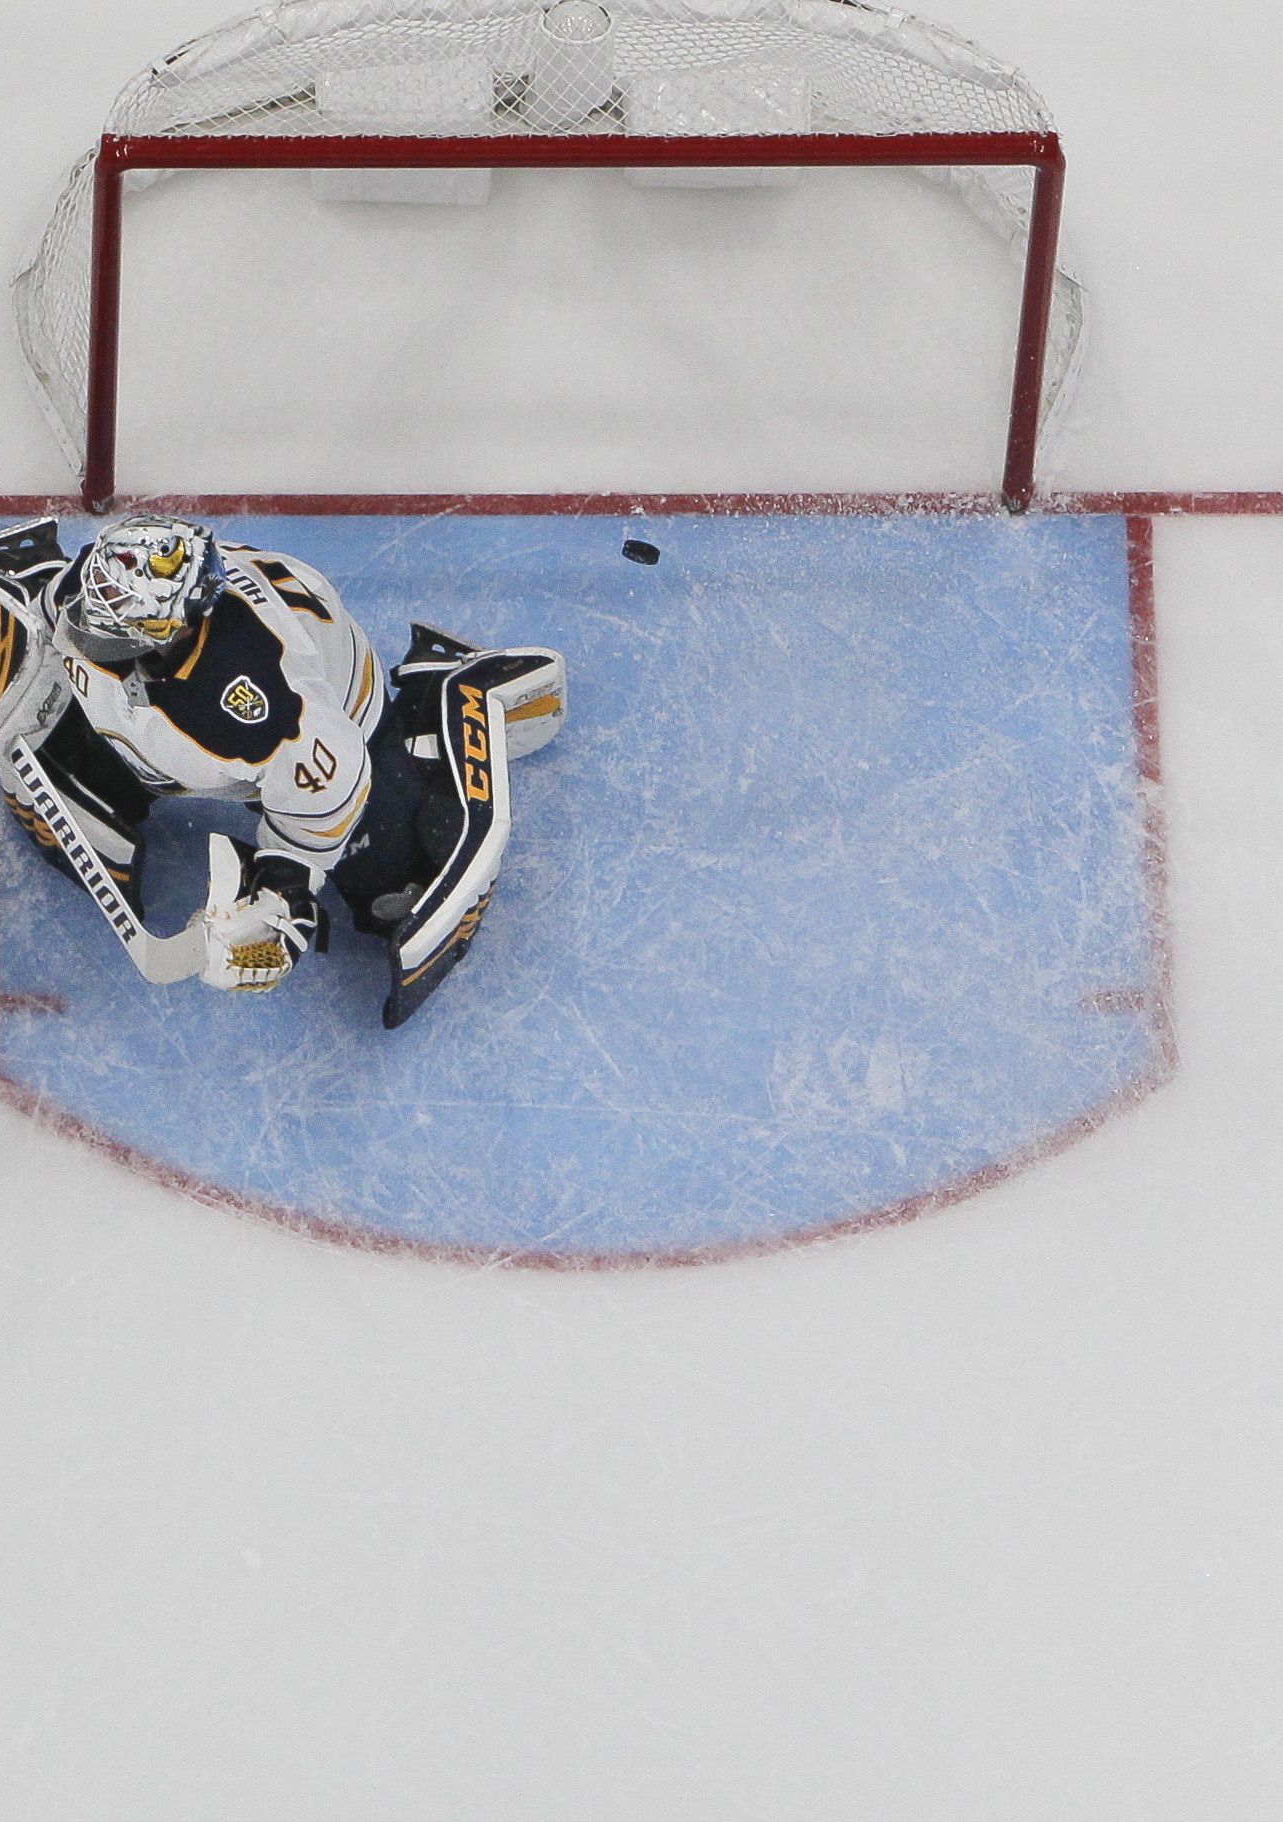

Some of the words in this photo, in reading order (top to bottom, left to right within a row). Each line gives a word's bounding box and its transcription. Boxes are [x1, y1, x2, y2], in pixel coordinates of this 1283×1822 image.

[221, 556, 269, 606] HUT
[63, 656, 90, 698] 40
[293, 737, 339, 795] 40
[459, 683, 491, 803] CCM
[10, 748, 139, 944] WARRIOR
